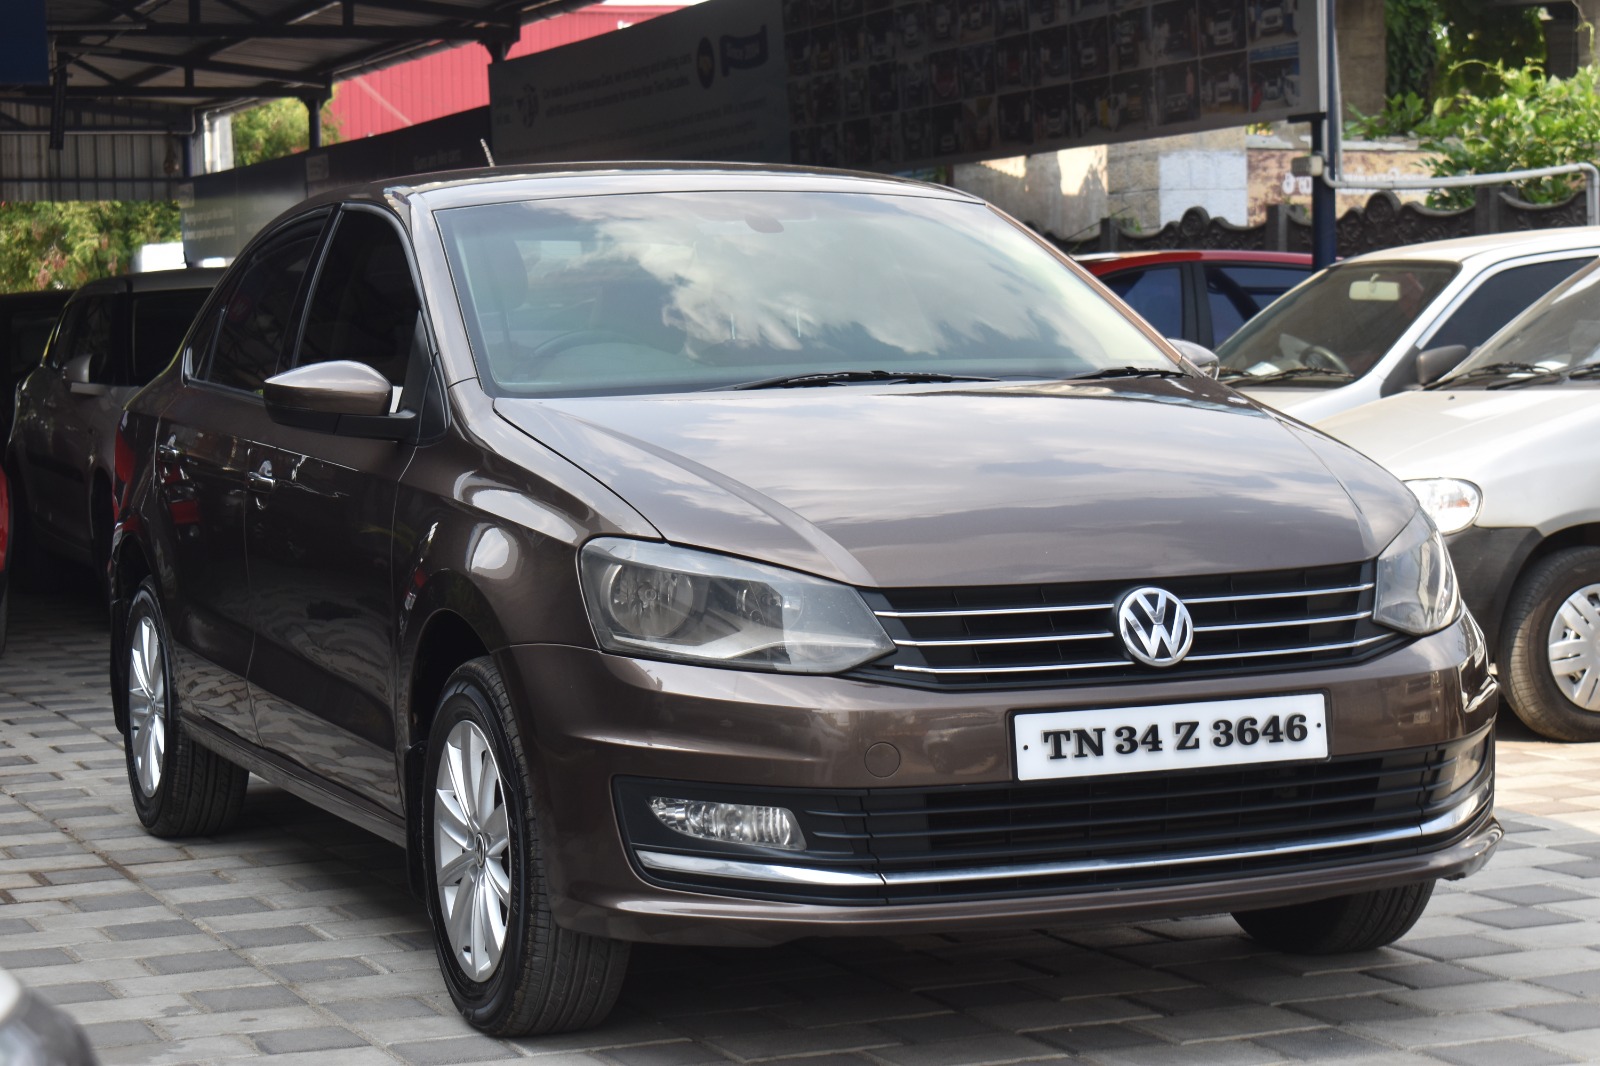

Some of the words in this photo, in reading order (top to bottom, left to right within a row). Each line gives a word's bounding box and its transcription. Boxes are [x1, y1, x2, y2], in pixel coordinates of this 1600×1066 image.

[1043, 727, 1106, 760] TN
[1114, 724, 1163, 755] 34
[1175, 721, 1200, 751] Z
[1212, 714, 1308, 748] 3646
